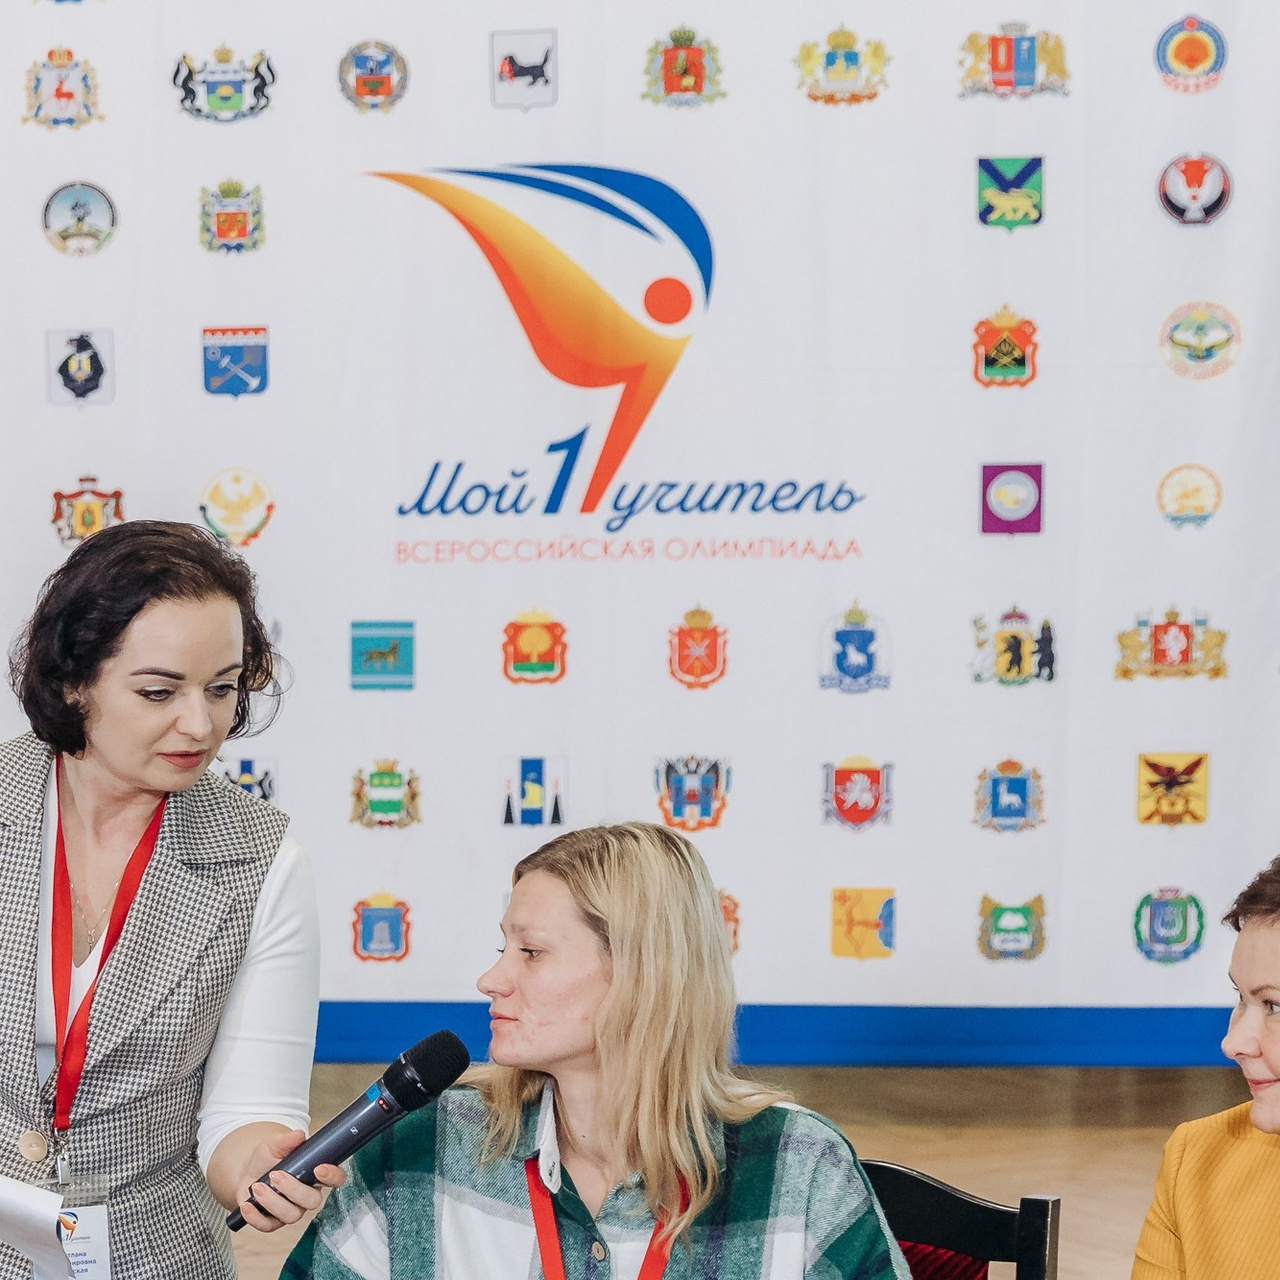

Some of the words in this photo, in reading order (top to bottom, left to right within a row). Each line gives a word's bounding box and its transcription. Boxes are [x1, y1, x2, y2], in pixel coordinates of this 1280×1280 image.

[396, 461, 537, 516] Мой
[605, 480, 867, 532] учитель
[395, 535, 655, 564] ВСЕРОССИЙСКАЯ
[663, 537, 864, 562] ОЛИМПИАДА
